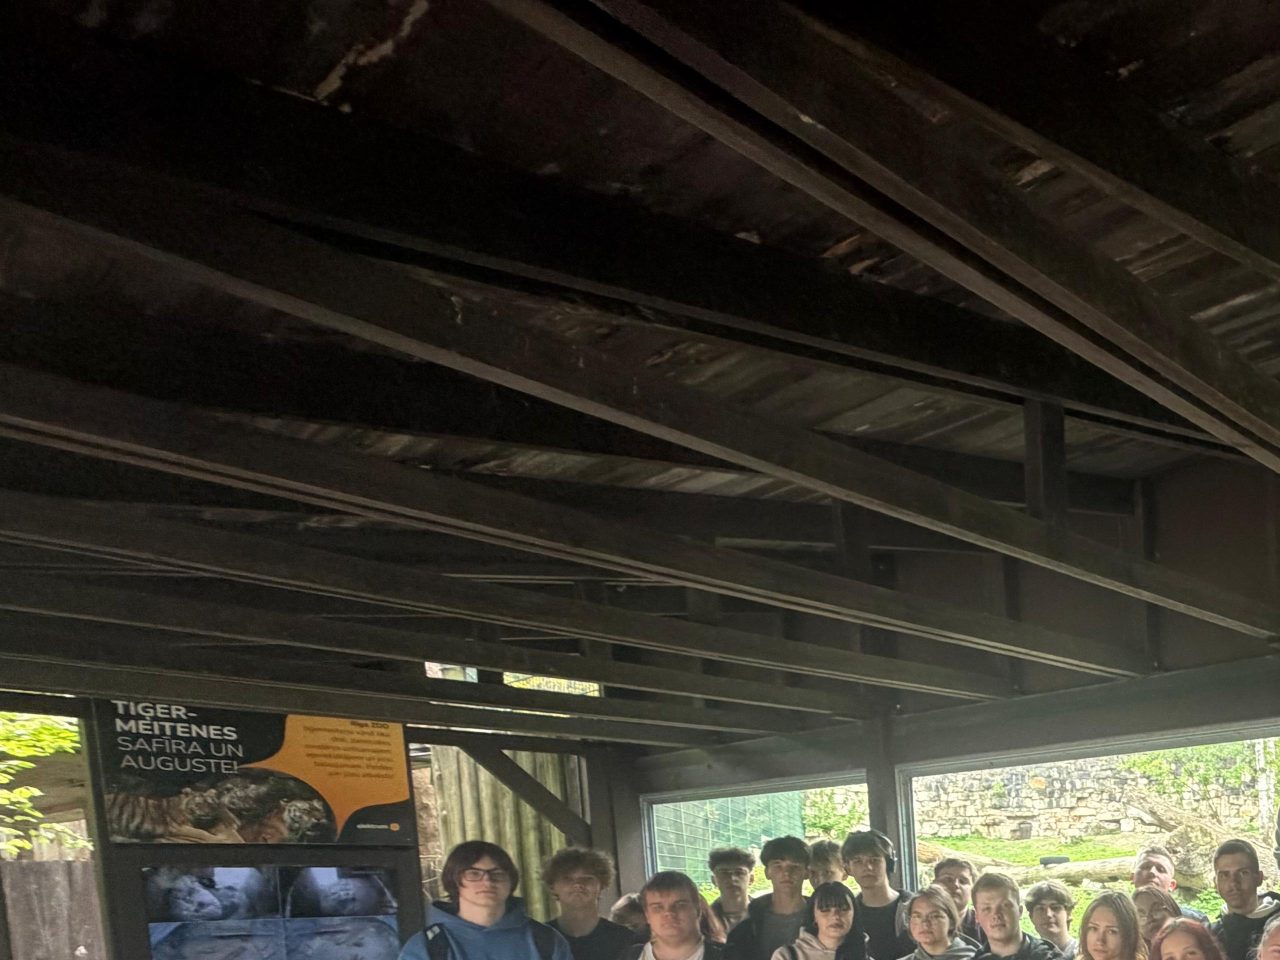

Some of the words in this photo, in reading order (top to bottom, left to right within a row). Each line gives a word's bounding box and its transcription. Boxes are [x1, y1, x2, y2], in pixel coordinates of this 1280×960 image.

[115, 718, 238, 740] MEITENES
[117, 736, 205, 756] SAFĪRA
[210, 742, 243, 757] UN
[120, 754, 239, 774] AUGUSTE!
